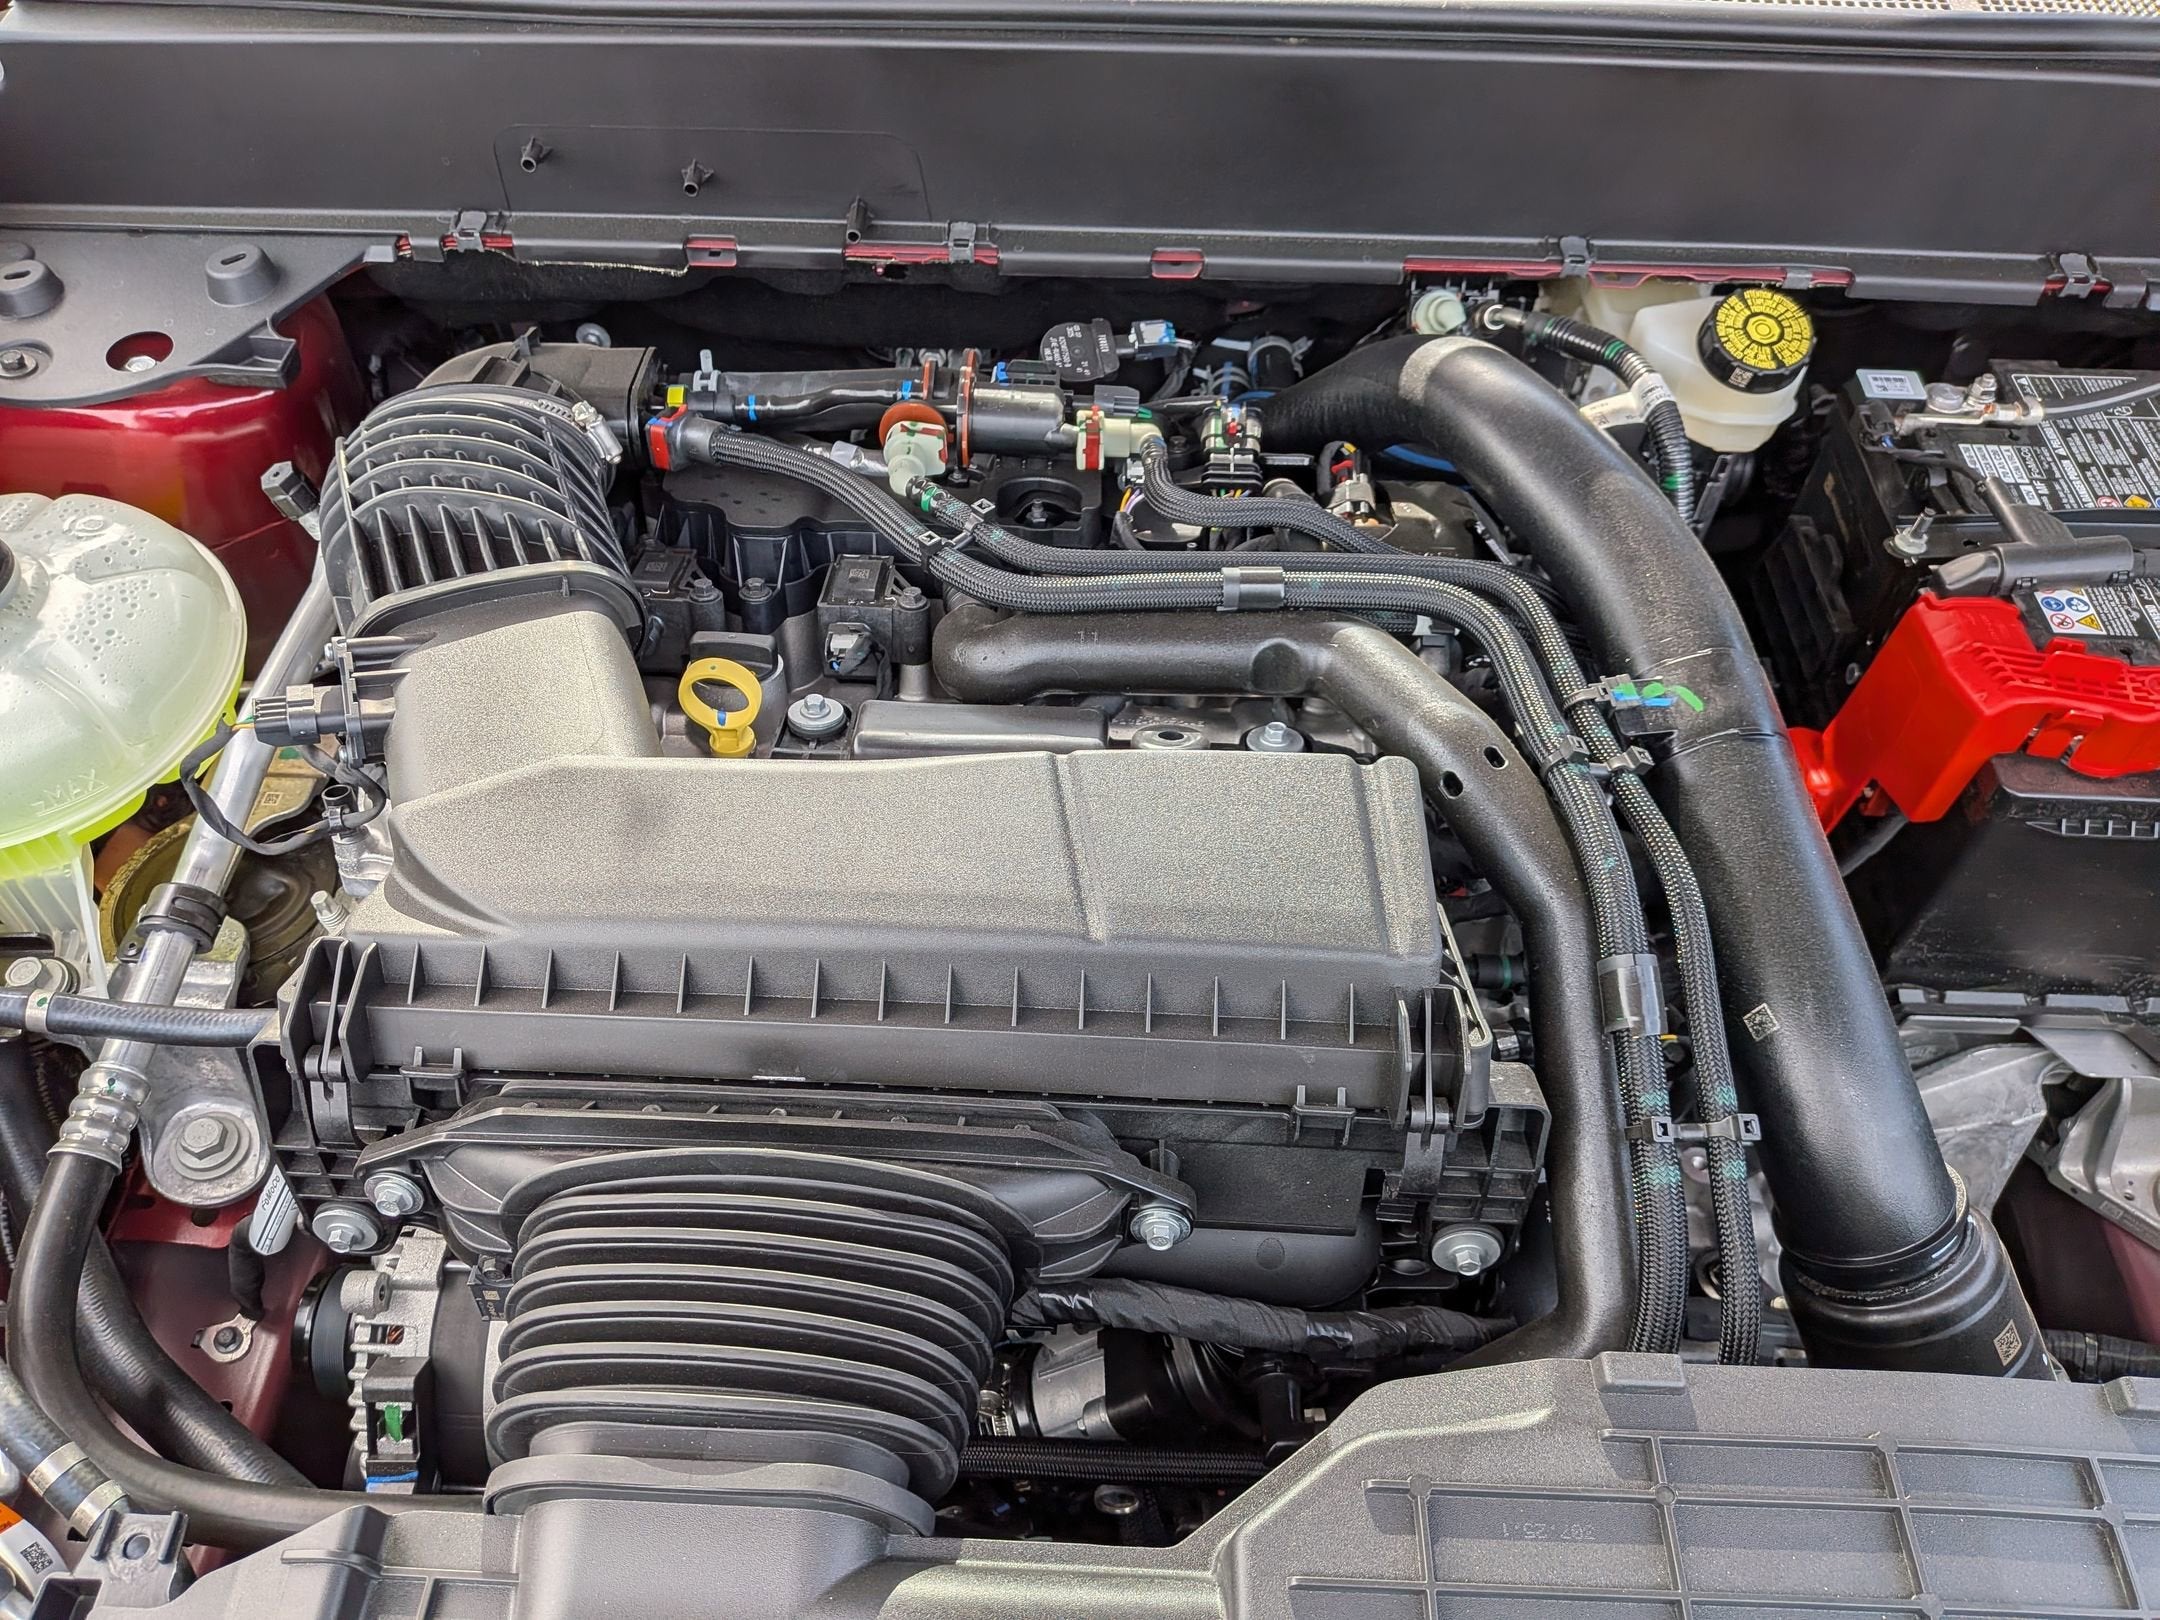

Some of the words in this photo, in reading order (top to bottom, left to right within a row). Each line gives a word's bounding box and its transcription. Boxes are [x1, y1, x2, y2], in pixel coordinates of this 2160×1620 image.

[2021, 447, 2040, 478] FoMoCo
[44, 769, 104, 807] MAX
[262, 1176, 281, 1211] FoMoCo
